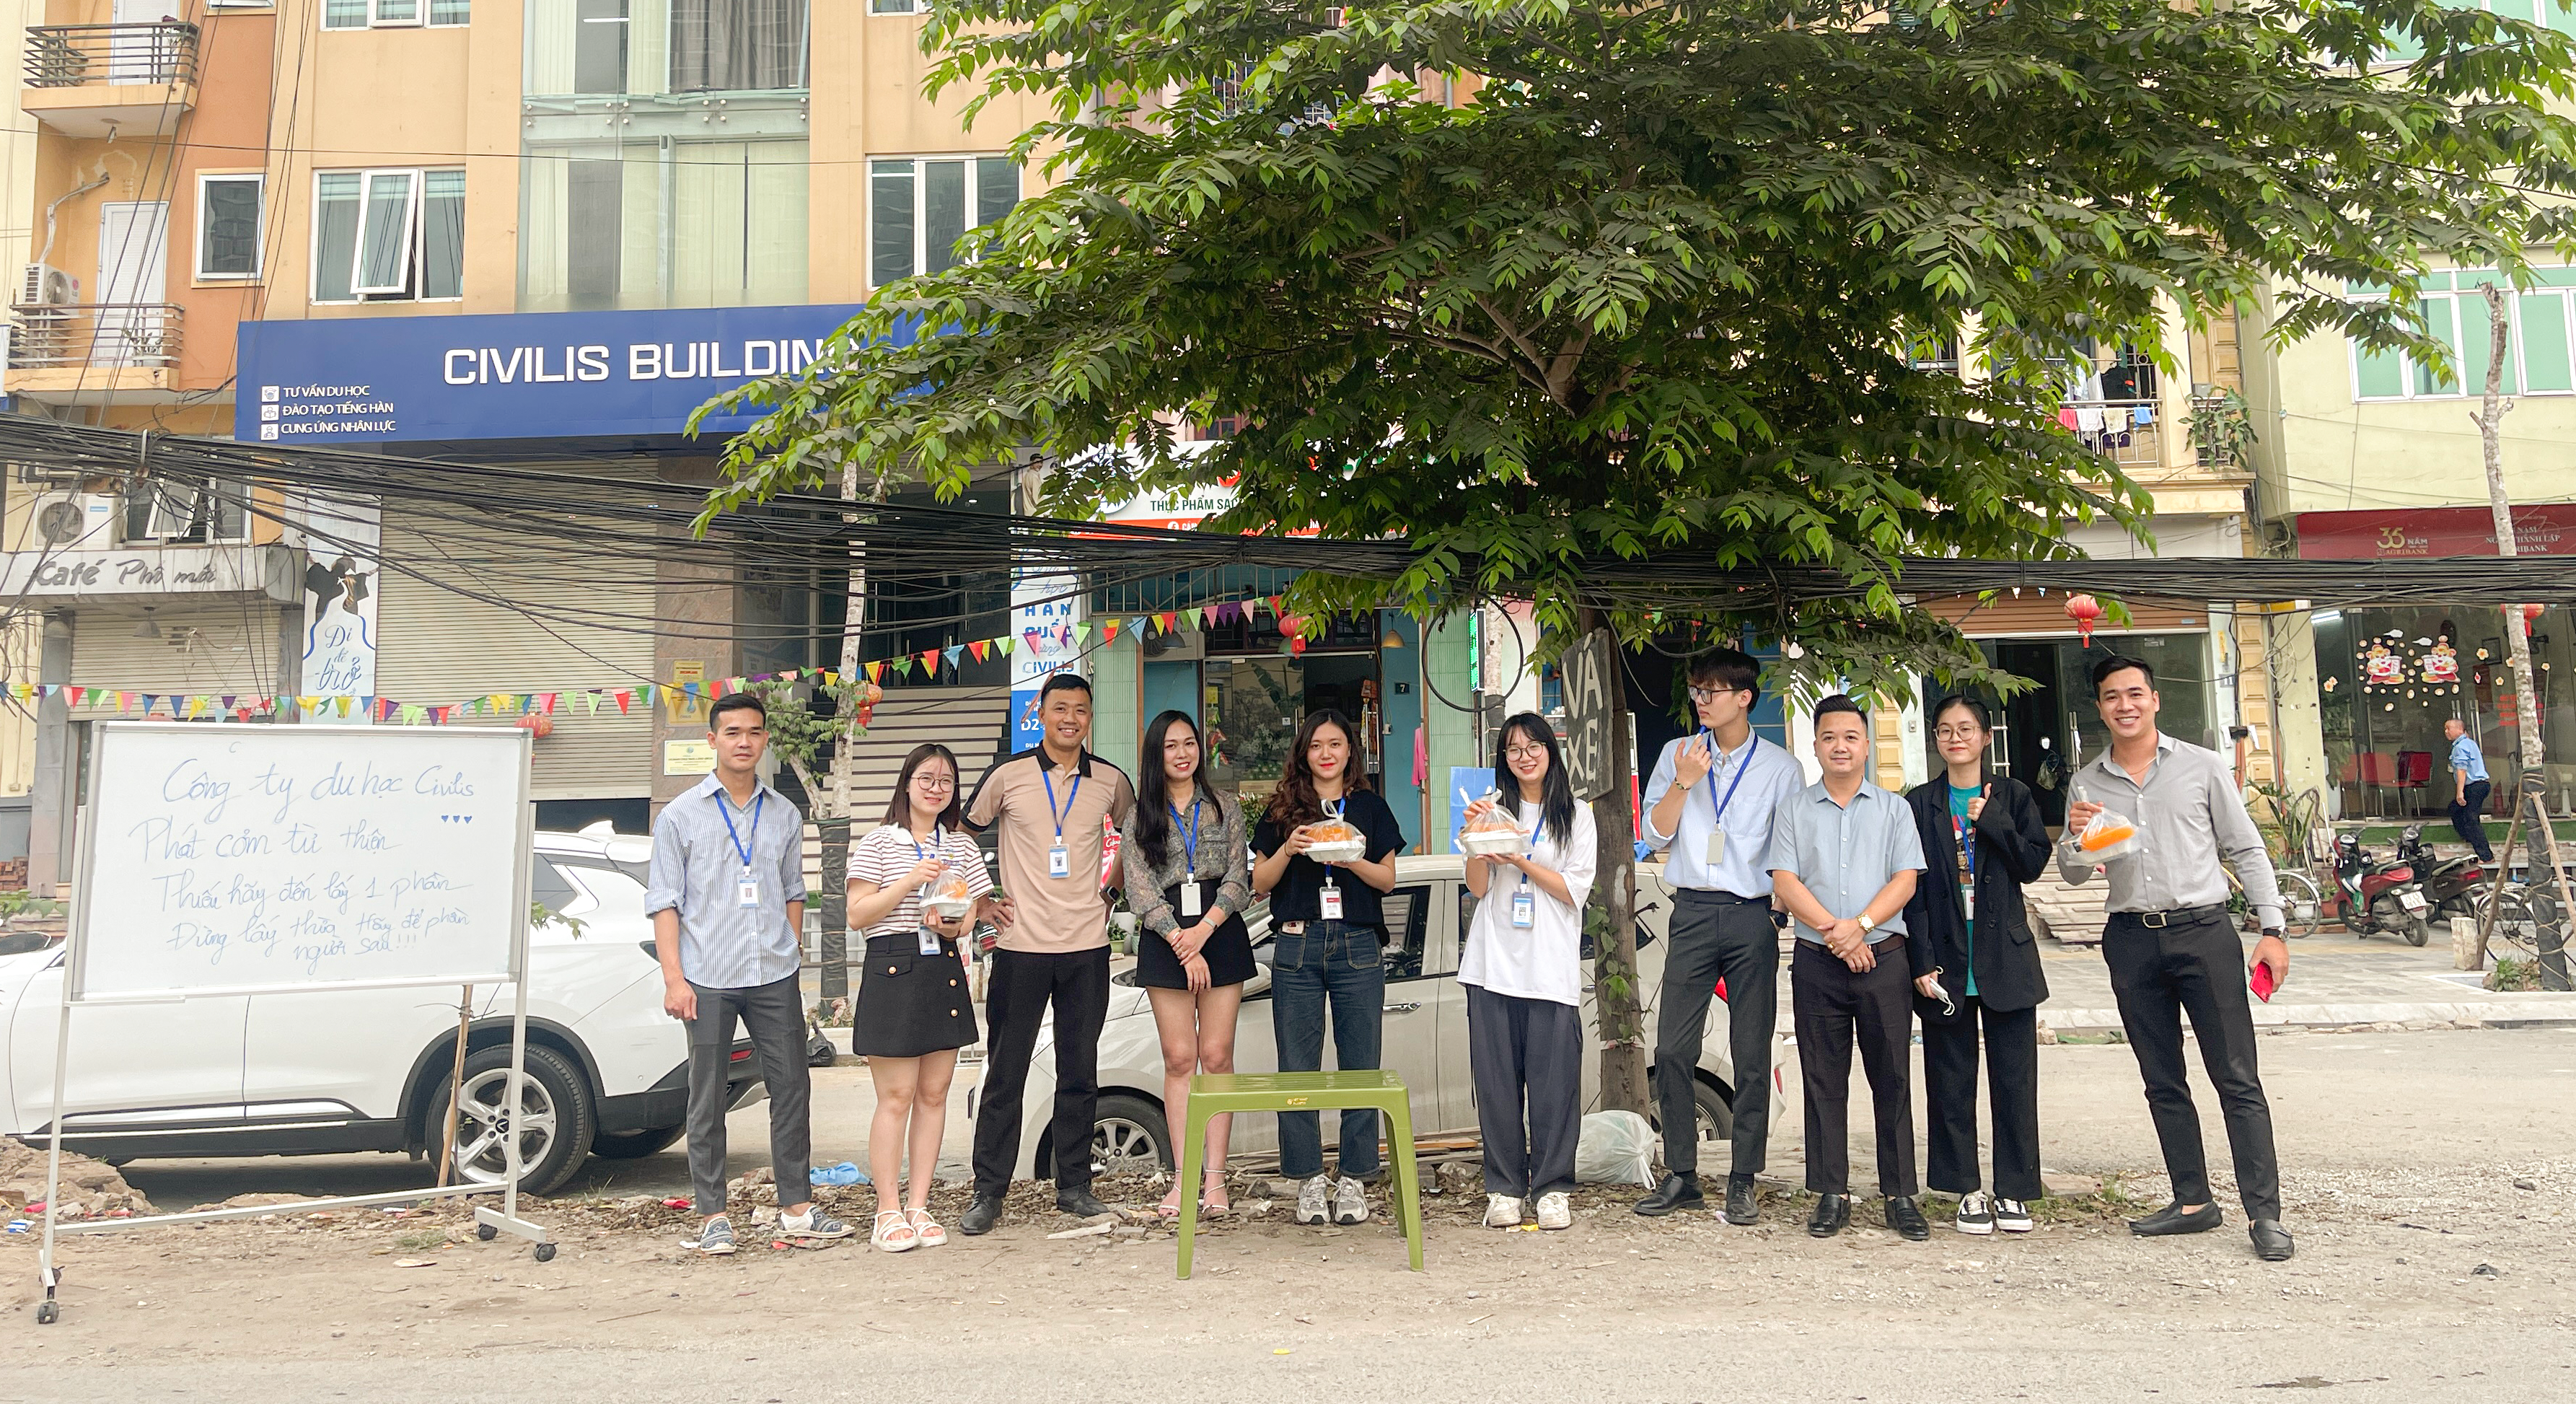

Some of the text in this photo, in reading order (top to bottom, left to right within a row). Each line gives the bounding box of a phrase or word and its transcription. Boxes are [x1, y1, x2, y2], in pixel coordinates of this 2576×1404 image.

[444, 345, 610, 385] CIVILIS
[283, 383, 370, 398] TƯ VẤN DU HỌC
[282, 400, 394, 417] ĐÀO TẠO TIẾNG HÀN
[281, 420, 396, 434] CUNG ỨNG NHÂN LỰC
[1182, 494, 1213, 511] PHẨM
[2376, 527, 2428, 549] 35 NĂM
[36, 558, 107, 586] Café
[1399, 684, 1405, 693] 7
[1562, 632, 1604, 719] VÁ
[1568, 717, 1598, 786] XE
[163, 758, 474, 825] Công ty du học Civilis
[128, 815, 206, 864] Phát
[340, 819, 403, 855] thiện
[228, 873, 277, 917] hãy
[279, 872, 317, 902] đến
[323, 871, 359, 916] lấy
[365, 877, 384, 898] 1
[237, 915, 283, 958] lấy
[401, 908, 425, 929] để
[425, 907, 470, 938] phần
